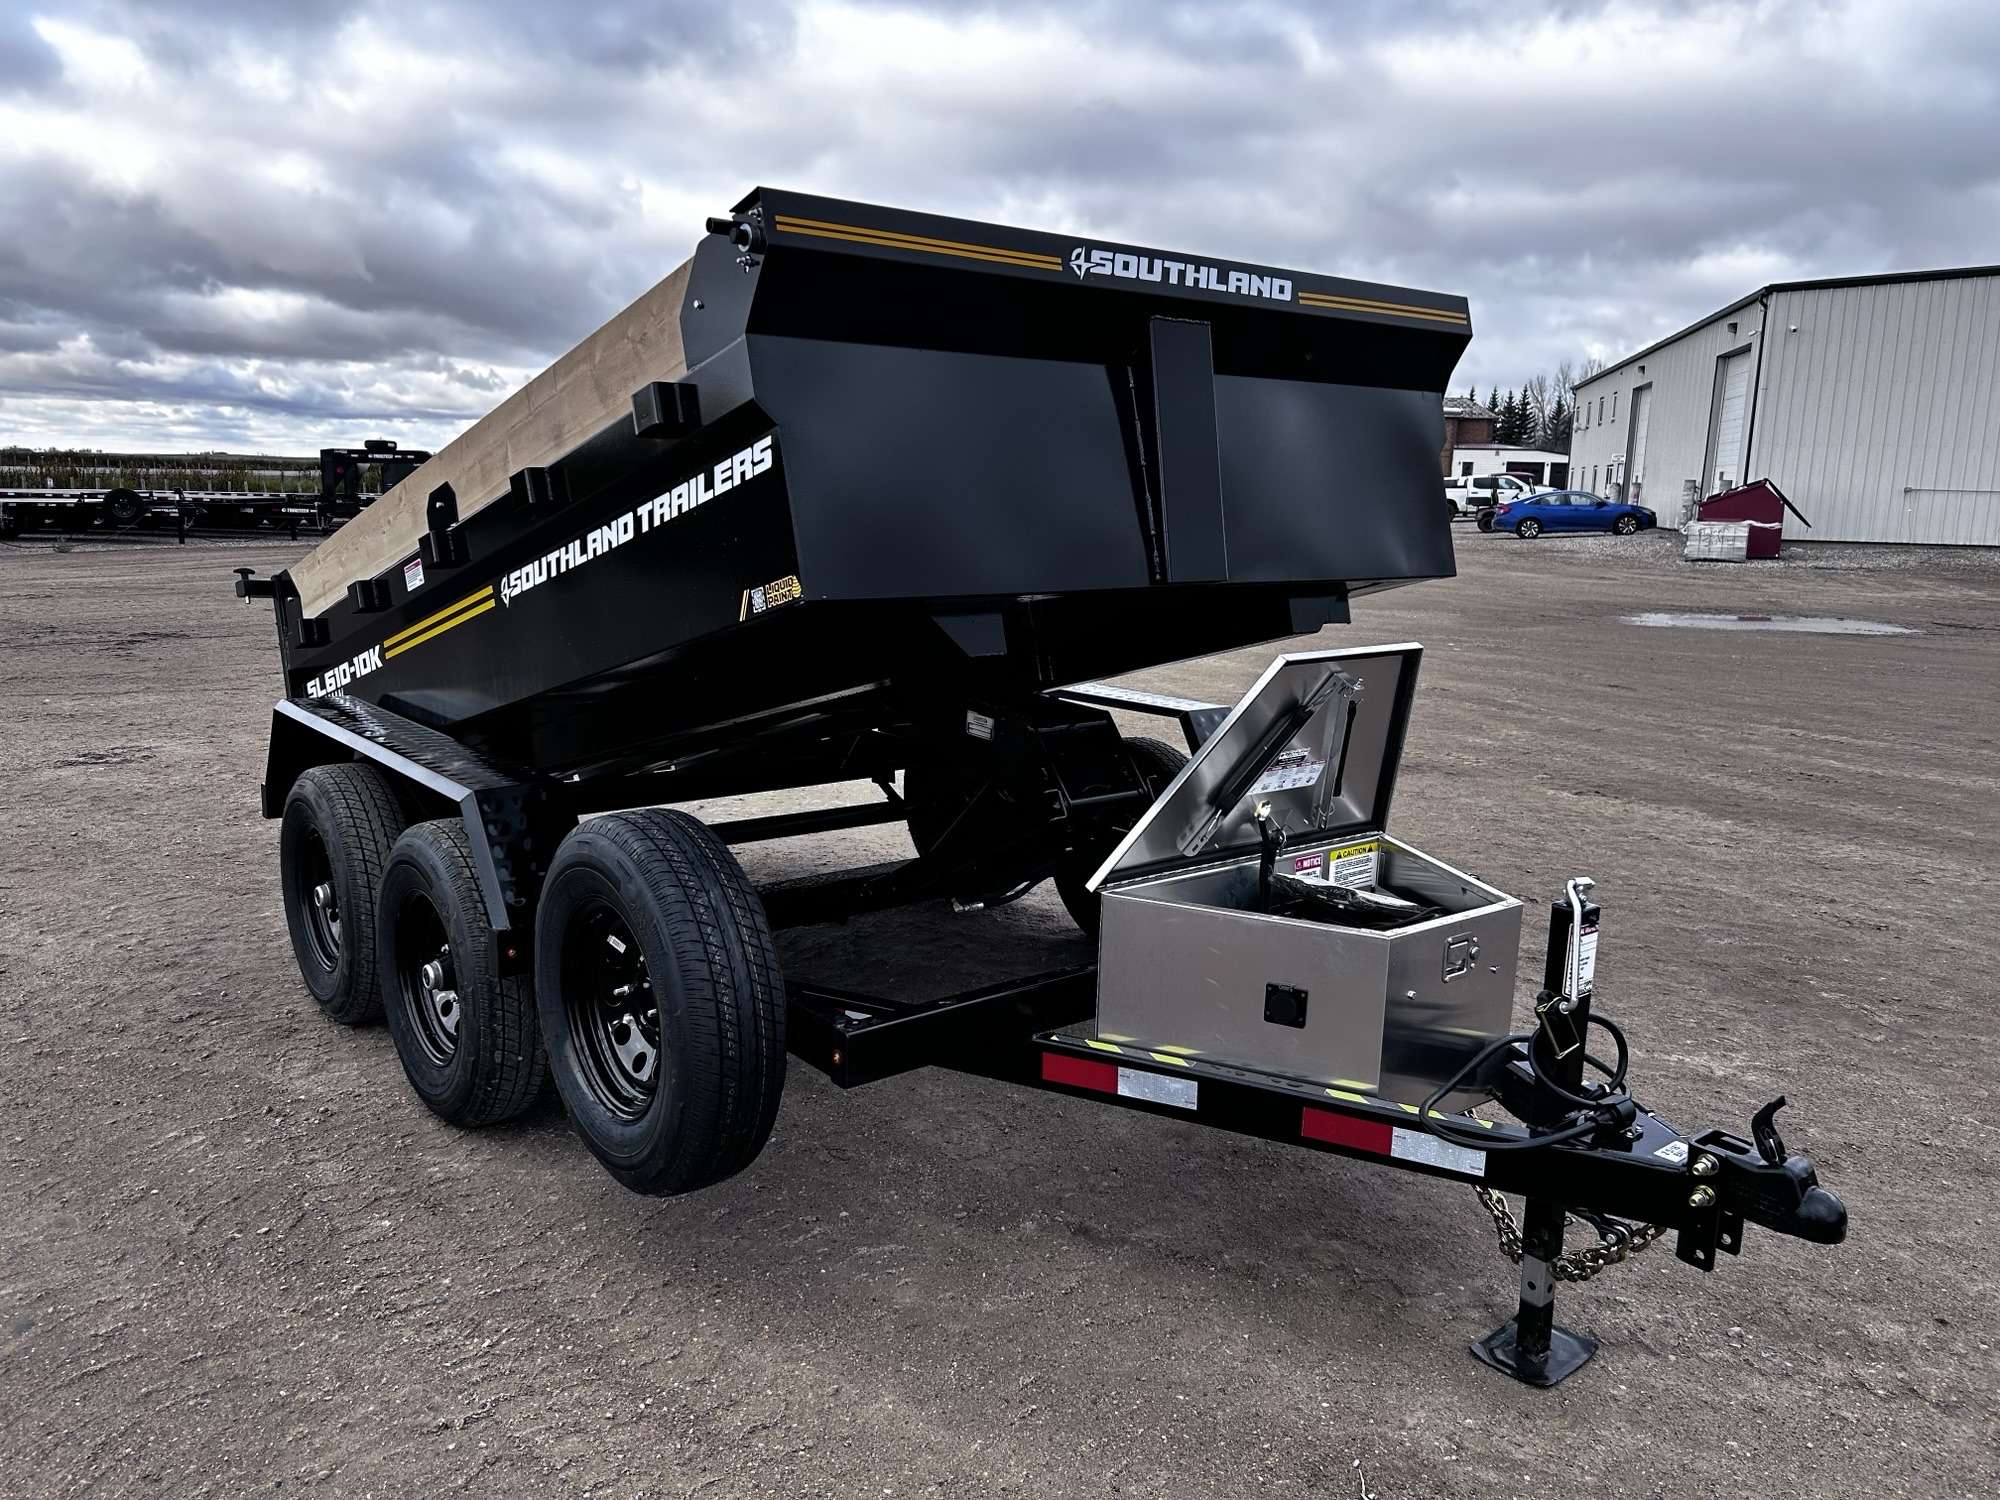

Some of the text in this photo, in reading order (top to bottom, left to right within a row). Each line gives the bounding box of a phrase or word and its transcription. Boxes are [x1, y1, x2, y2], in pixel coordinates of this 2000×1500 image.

[1089, 249, 1293, 302] SOUTHLAND
[508, 435, 772, 598] SOUTHLAND TRAILERS
[766, 576, 794, 596] LIQUID
[767, 590, 794, 608] PAINT
[306, 645, 383, 699] SL610-10K
[1343, 847, 1367, 858] CAUTION
